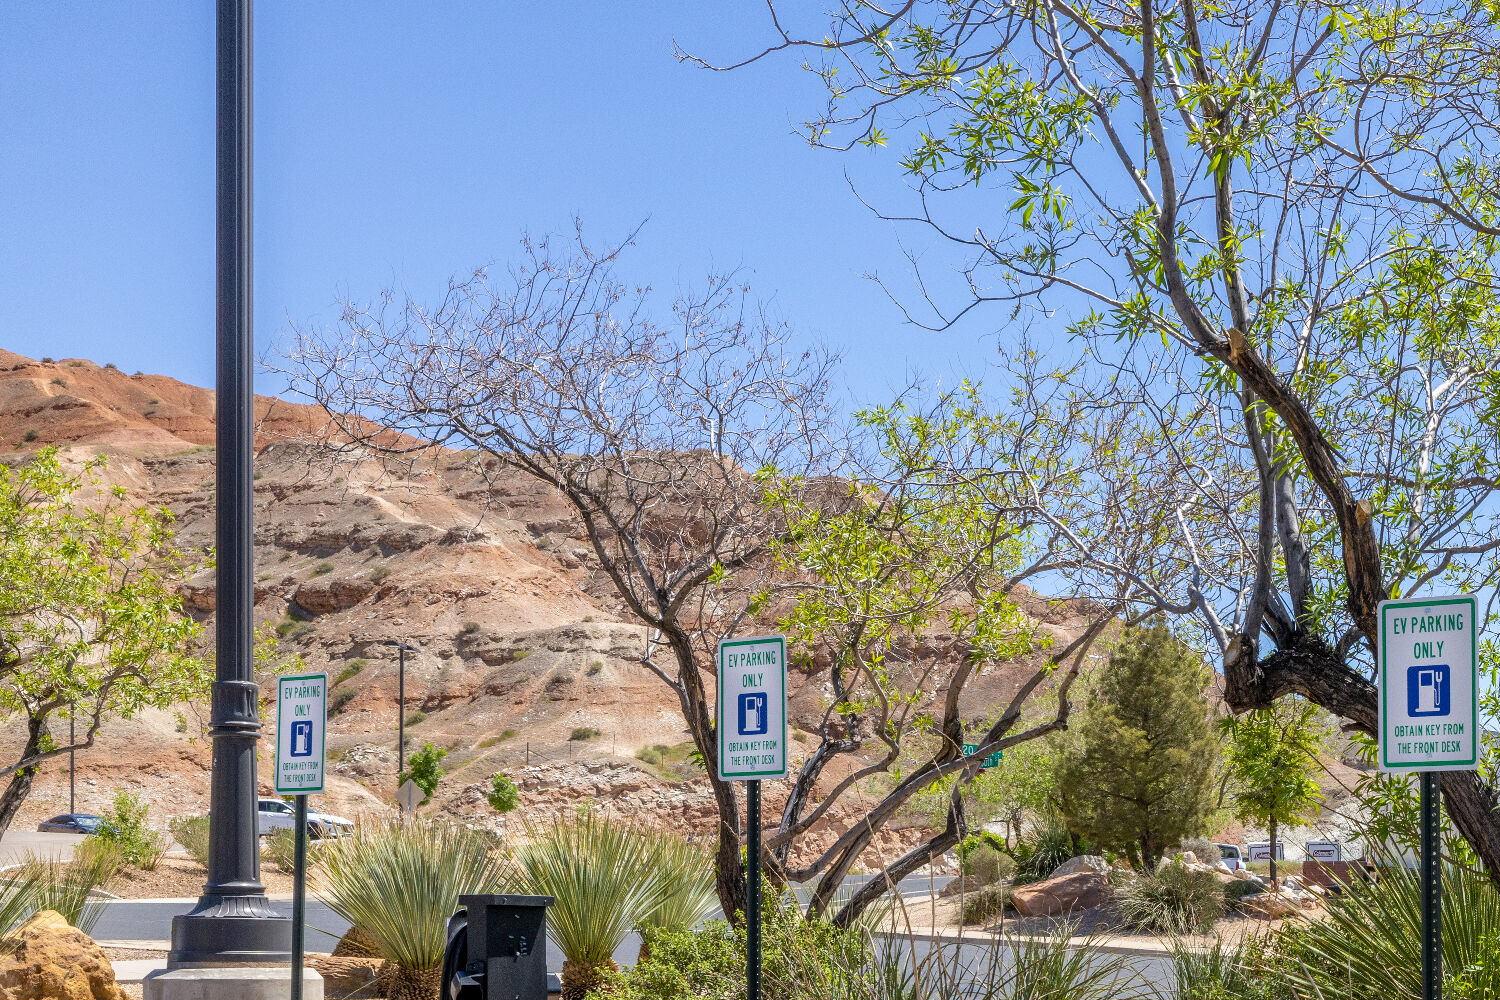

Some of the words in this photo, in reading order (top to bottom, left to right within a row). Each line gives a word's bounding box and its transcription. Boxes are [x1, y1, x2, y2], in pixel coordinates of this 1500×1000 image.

[1394, 617, 1407, 634] EV
[1412, 614, 1463, 633] PARKING
[1414, 641, 1444, 659] ONLY
[729, 654, 738, 668] EV
[740, 651, 776, 666] PARKING
[742, 673, 763, 688] ONLY
[285, 687, 292, 699] EV
[295, 685, 320, 698] PARKING
[295, 704, 310, 716] ONLY
[1394, 725, 1423, 738] OBTAIN
[1426, 724, 1440, 736] KEY
[1443, 723, 1464, 735] FROM
[729, 742, 748, 752] OBTAIN
[751, 741, 761, 751] KEY
[762, 740, 777, 750] FROM
[1398, 742, 1411, 754] THE
[1414, 741, 1439, 753] FRONT
[1441, 740, 1461, 752] DESK
[283, 762, 298, 771] OBTAIN
[299, 762, 307, 770] KEY
[731, 756, 741, 766] THE
[742, 755, 760, 765] FRONT
[762, 754, 775, 764] DESK
[284, 774, 292, 782] THE
[293, 774, 306, 782] FRONT
[307, 773, 316, 781] DESK
